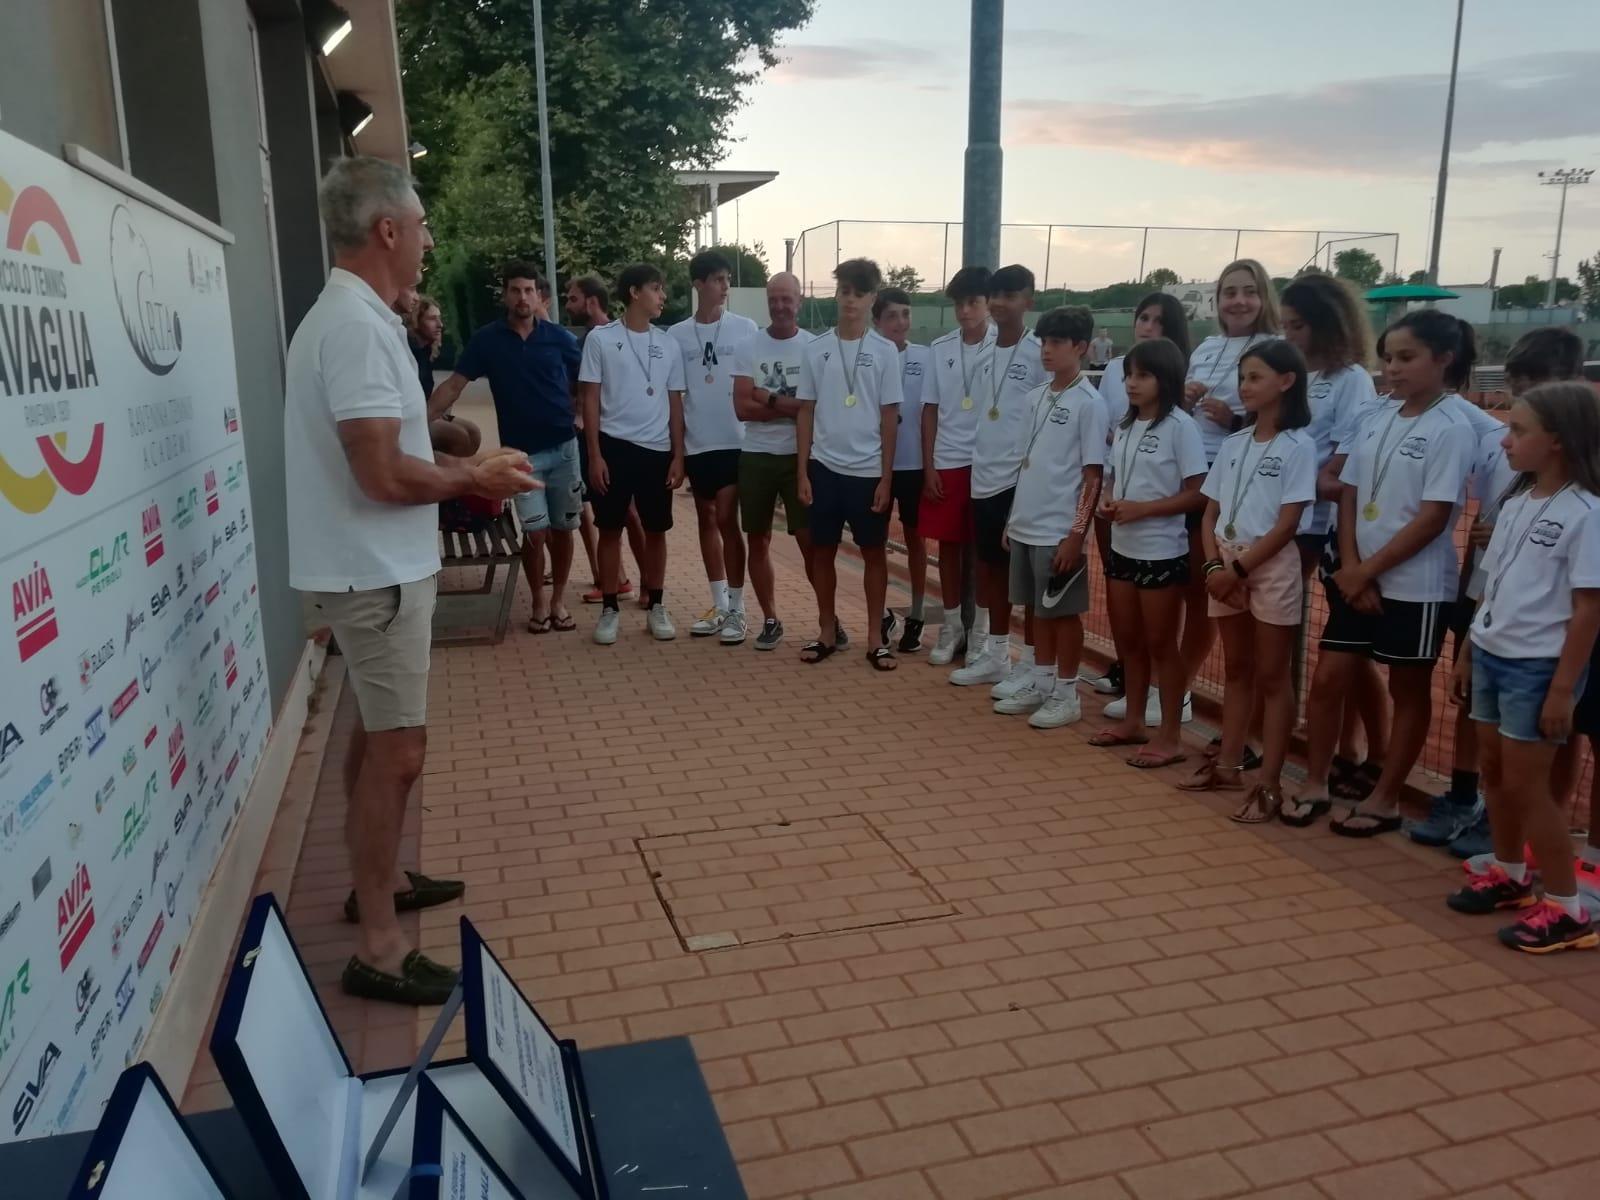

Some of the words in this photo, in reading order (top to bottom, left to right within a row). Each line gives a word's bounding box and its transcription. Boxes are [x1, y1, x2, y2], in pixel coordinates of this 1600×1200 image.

[0, 258, 32, 295] COLO
[32, 264, 67, 299] TENNIS
[13, 1041, 62, 1137] SVA
